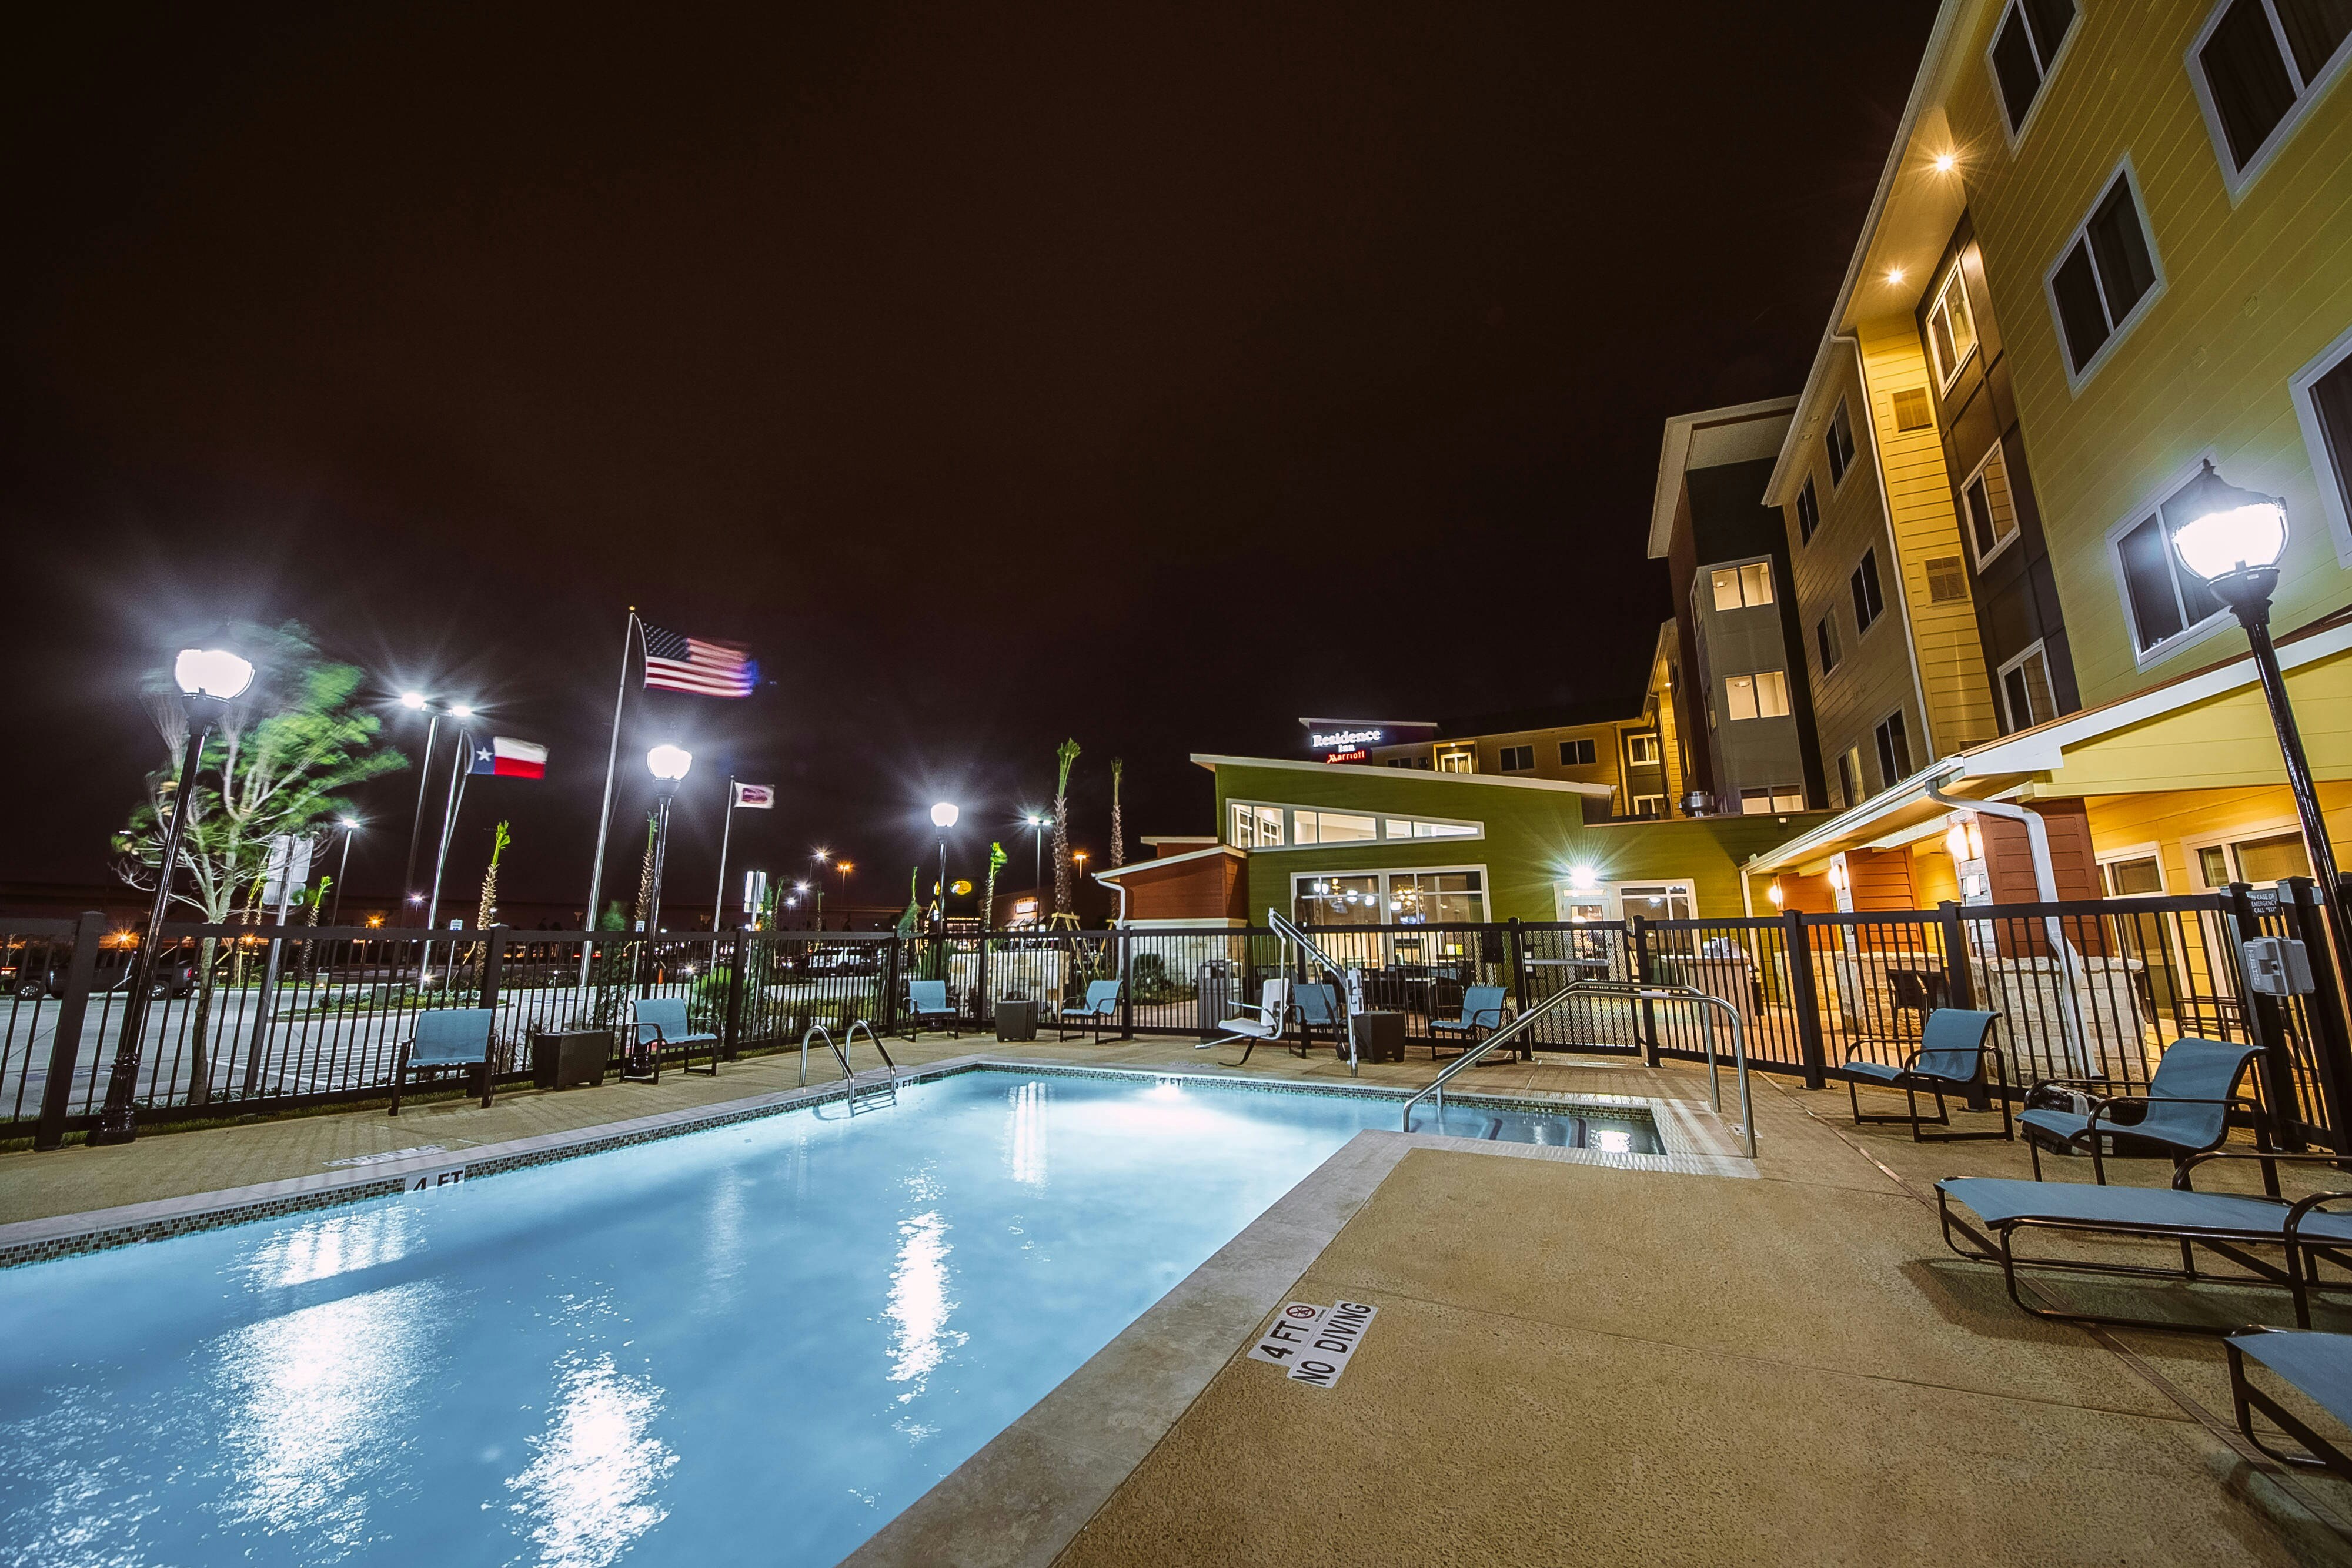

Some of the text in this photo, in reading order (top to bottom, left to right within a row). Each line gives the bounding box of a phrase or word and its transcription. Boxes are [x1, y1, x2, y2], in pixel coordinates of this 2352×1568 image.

[1312, 730, 1381, 747] Residence
[1327, 750, 1365, 764] Marriott
[902, 1079, 912, 1088] FT
[1170, 1078, 1182, 1086] FT
[437, 1170, 463, 1187] FT
[1260, 1320, 1309, 1360] 4 FT
[1291, 1303, 1372, 1386] NO DIVING
